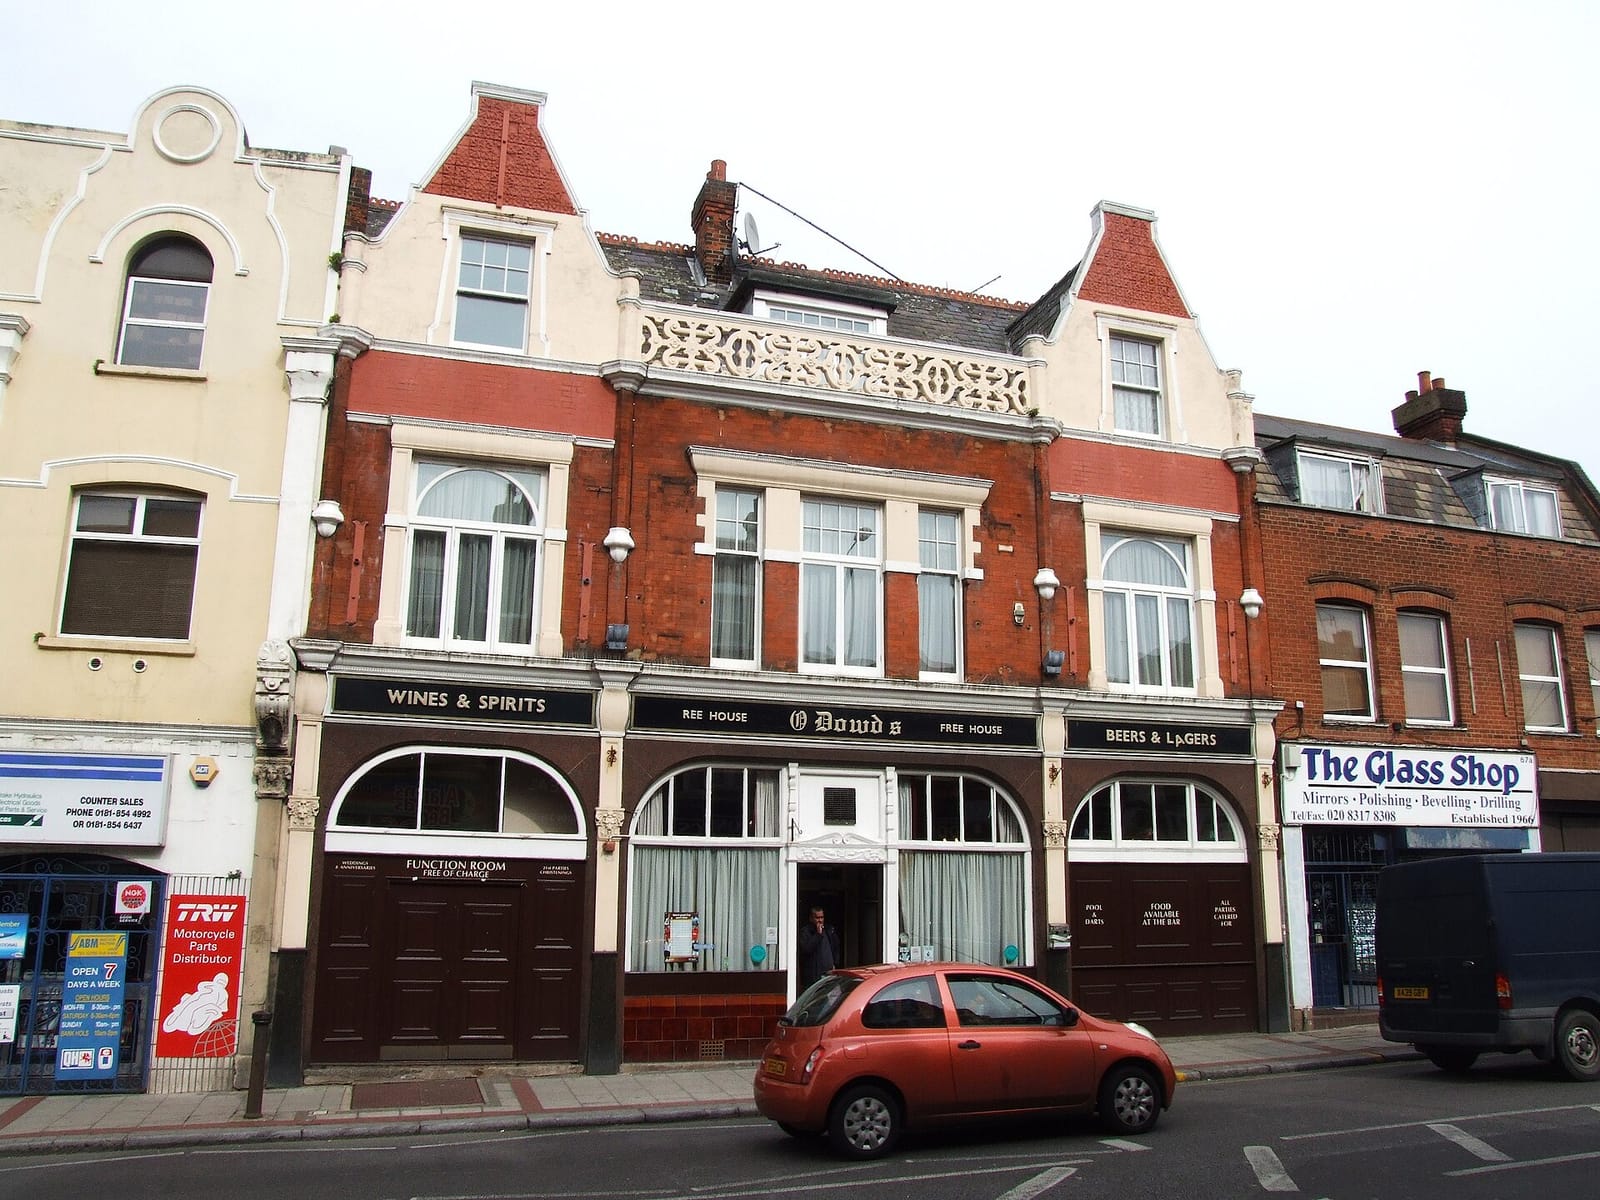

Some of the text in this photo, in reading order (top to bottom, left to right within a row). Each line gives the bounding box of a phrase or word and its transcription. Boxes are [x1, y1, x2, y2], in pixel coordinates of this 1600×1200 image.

[387, 689, 546, 713] WINES & SPIRITS
[682, 709, 748, 722] REE HOUSE
[940, 723, 1003, 735] FREE HOUSE
[1106, 729, 1217, 748] BEERS & LAGERS
[1301, 748, 1520, 796] The Glass Shop
[80, 796, 144, 806] COUNTER SALES
[1303, 791, 1522, 811] Mirrors Polishing Bevelling Drilling
[66, 808, 94, 817] PHONE
[132, 810, 152, 818] 4992
[1327, 809, 1345, 821] 020
[1347, 810, 1370, 822] 8317
[1373, 811, 1396, 822] 8308
[1451, 813, 1509, 824] Established
[73, 820, 84, 828] OR
[123, 821, 143, 830] 6437
[406, 859, 506, 871] FUNCTION ROOM
[423, 869, 490, 878] FREE OF CHARGE
[125, 889, 143, 897] NGK
[1150, 902, 1172, 910] FOOD
[177, 903, 239, 922] TRW
[0, 920, 20, 928] ember
[1142, 918, 1181, 926] AT THE BAR
[173, 928, 236, 940] Motorcycle
[79, 938, 99, 949] ABM
[189, 941, 218, 951] Parts
[172, 953, 233, 964] Distributor
[72, 962, 118, 980] OPEN 7
[98, 980, 121, 988] WEEK
